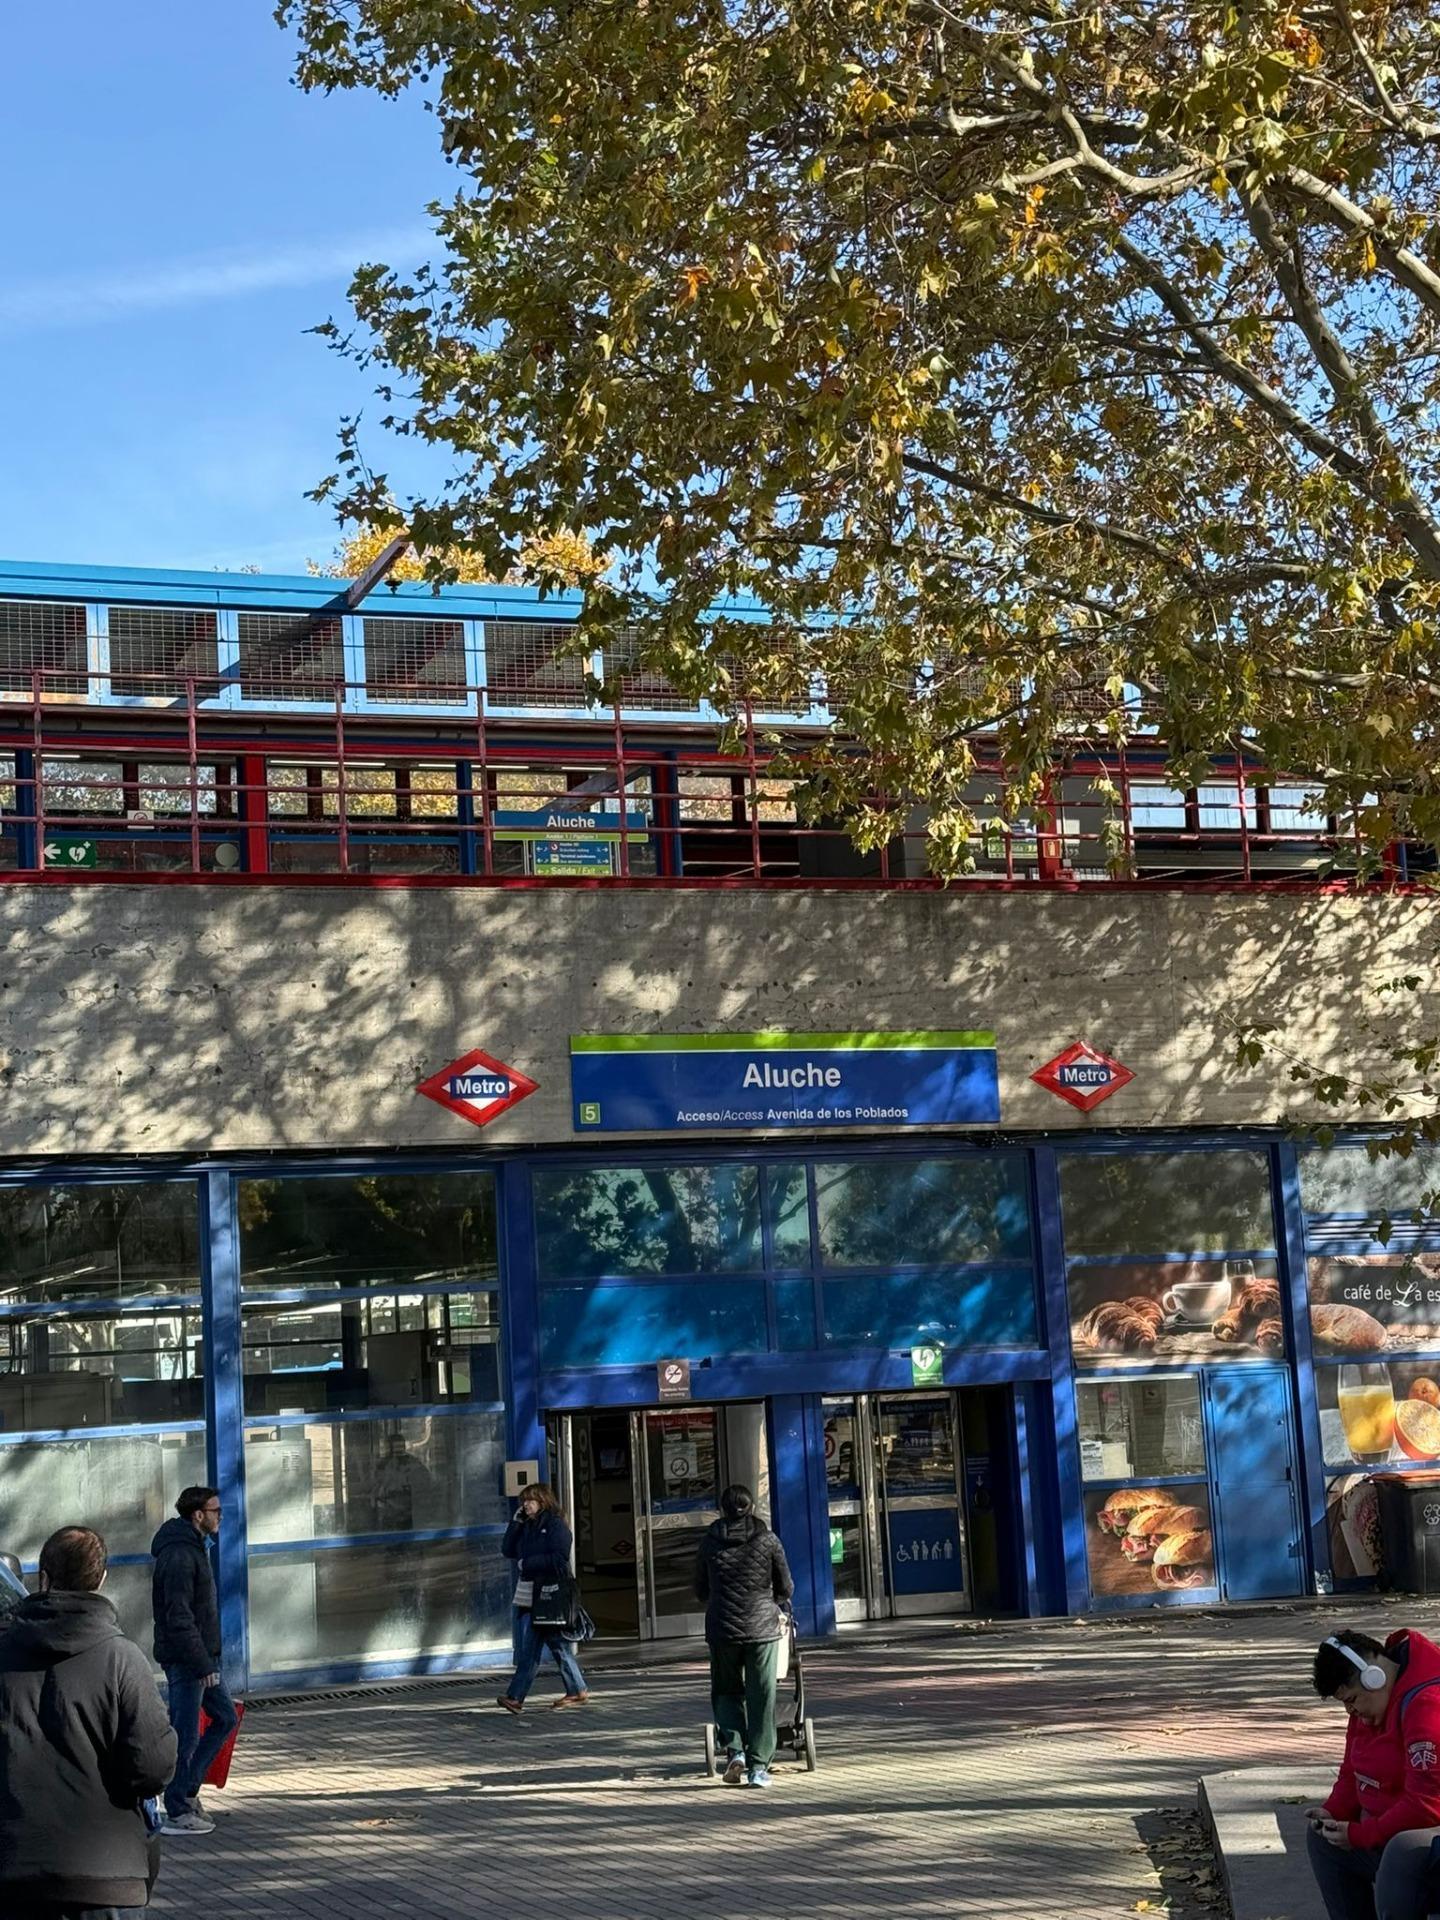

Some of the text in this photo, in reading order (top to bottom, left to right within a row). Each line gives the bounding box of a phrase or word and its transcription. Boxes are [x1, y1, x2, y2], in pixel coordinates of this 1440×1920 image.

[547, 815, 596, 828] Aluche
[742, 1062, 842, 1089] Aluche
[1064, 1068, 1108, 1083] Metro
[456, 1078, 506, 1095] Metro
[584, 1105, 597, 1122] 5
[767, 1108, 814, 1120] Avenida
[817, 1107, 832, 1119] de
[834, 1107, 853, 1119] los
[855, 1106, 909, 1119] Poblados
[1343, 1283, 1372, 1300] café
[1375, 1284, 1392, 1301] de
[1392, 1279, 1423, 1308] La
[577, 1427, 592, 1542] Metro
